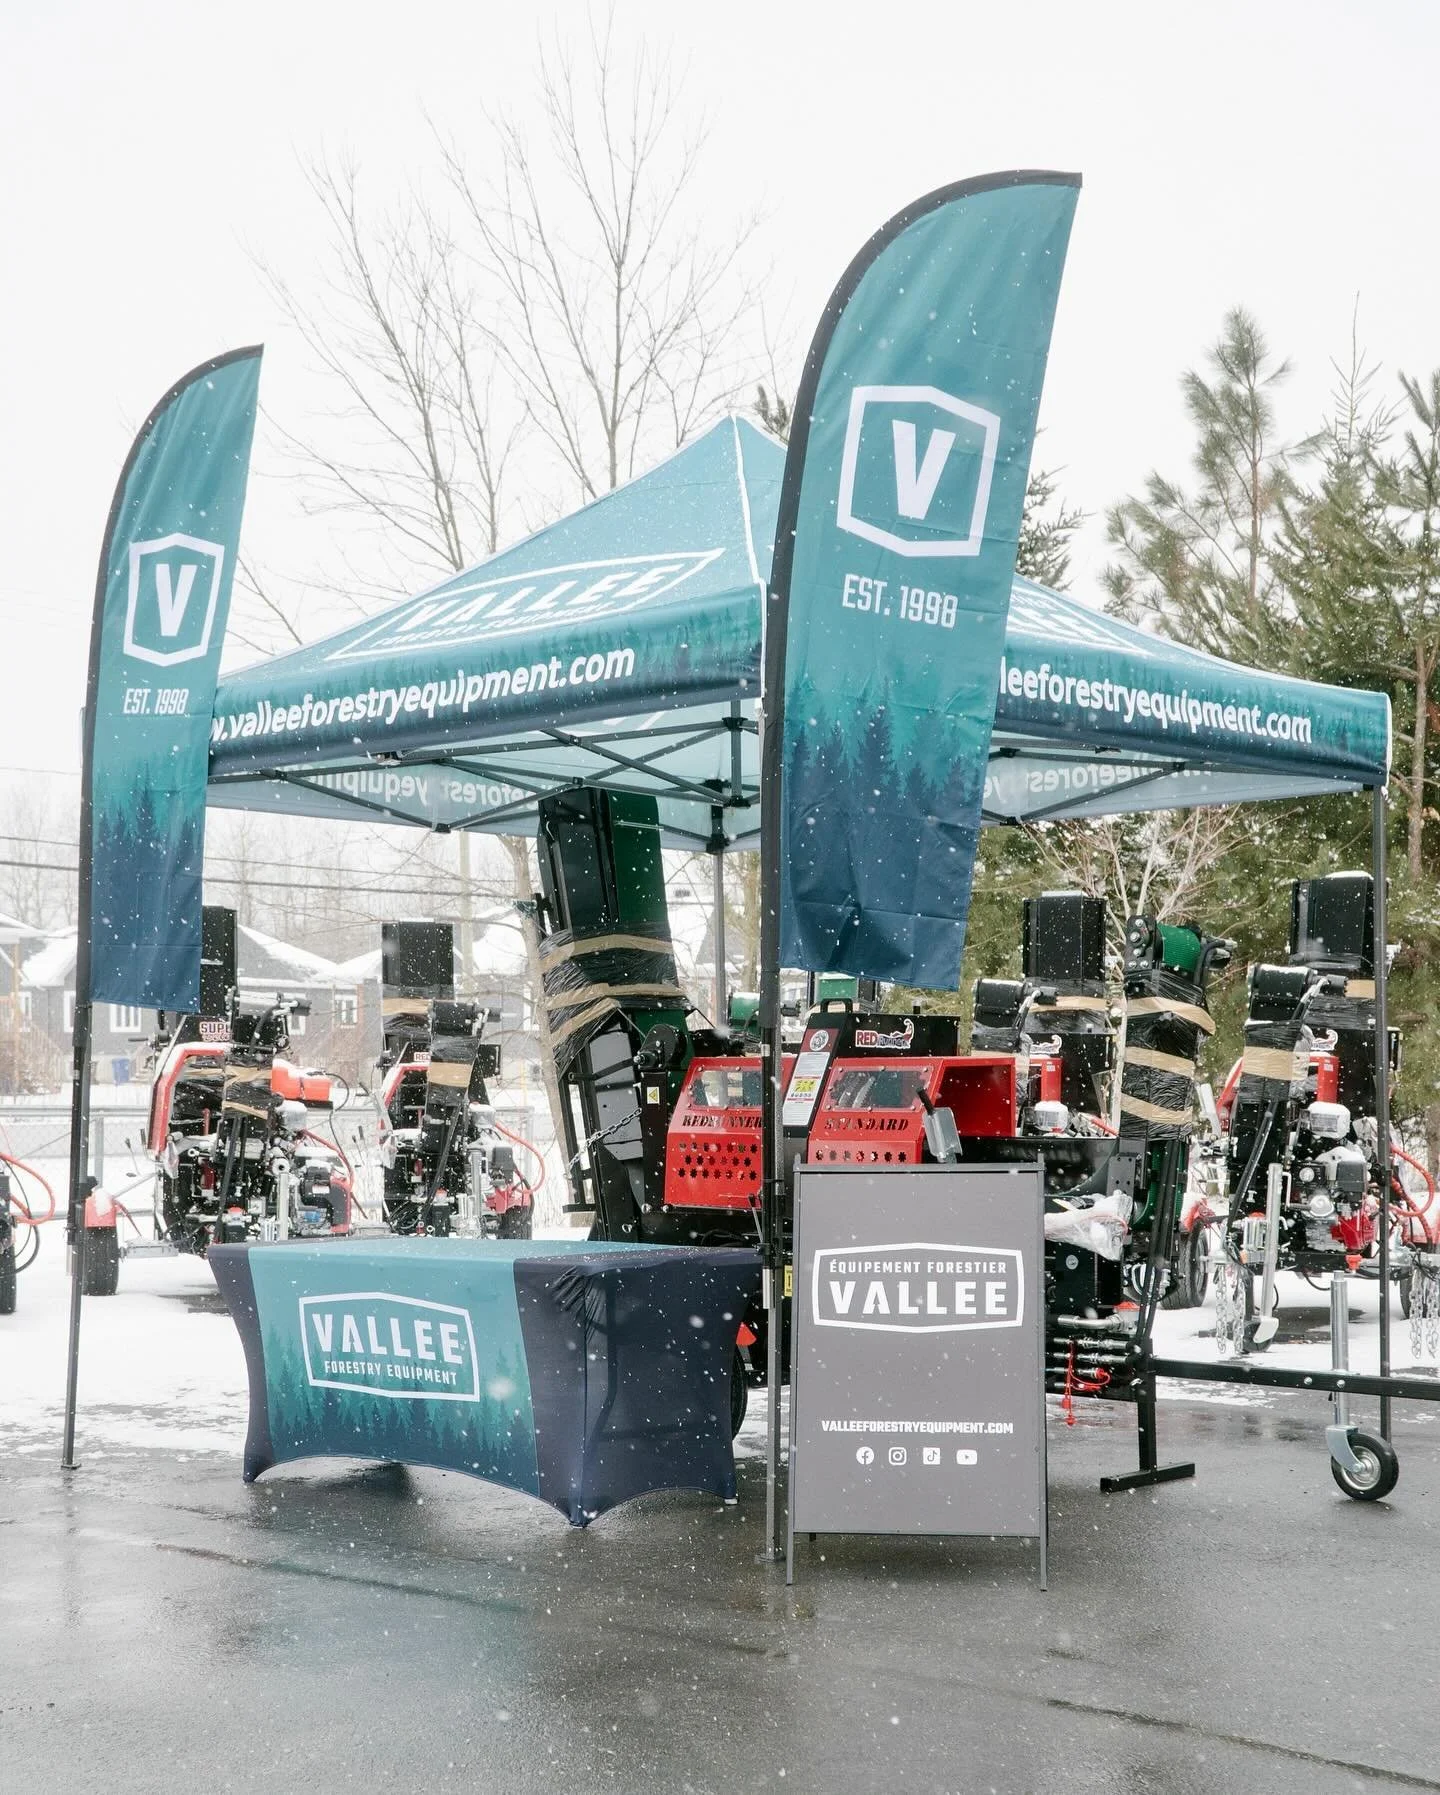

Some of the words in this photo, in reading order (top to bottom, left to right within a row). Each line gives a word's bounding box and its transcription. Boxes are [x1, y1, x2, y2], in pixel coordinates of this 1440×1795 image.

[892, 419, 956, 520] V
[155, 563, 197, 637] V
[397, 563, 685, 632] VALLEE
[842, 573, 891, 616] EST.
[899, 585, 958, 629] 1998
[123, 688, 150, 714] EST.
[154, 688, 189, 715] 1998
[824, 1118, 909, 1131] STANDARD
[829, 1259, 921, 1274] ÉQUIPEMENT
[927, 1261, 1007, 1274] FORESTIER
[829, 1281, 1008, 1315] VALLEE
[312, 1313, 463, 1364] VALLEE
[324, 1360, 382, 1376] FORESTRY
[387, 1364, 457, 1385] EQUIPMENT
[821, 1420, 1014, 1434] VALLEEFORESTRYEQUIPMENT.COM
